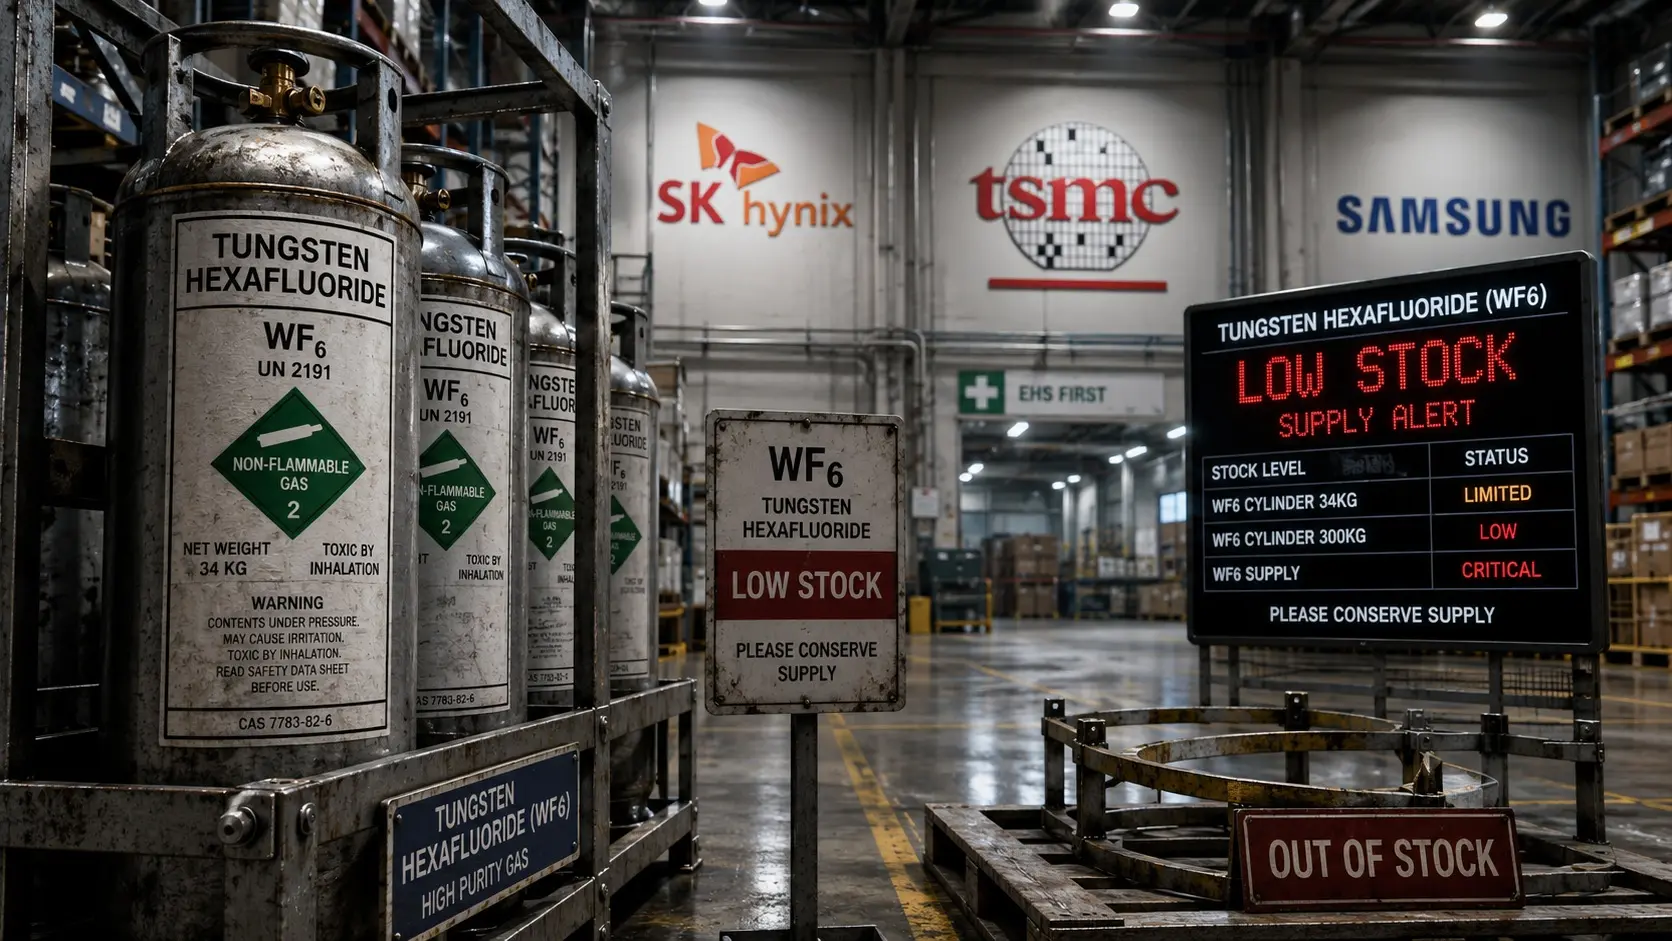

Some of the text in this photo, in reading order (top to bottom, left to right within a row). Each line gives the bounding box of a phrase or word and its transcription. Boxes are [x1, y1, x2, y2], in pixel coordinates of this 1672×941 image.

[969, 166, 1179, 224] tsmc
[657, 180, 854, 238] SK hynix
[1336, 194, 1570, 238] SAMSUNG
[212, 233, 369, 272] TUNGSTEN
[186, 266, 386, 308] HEXAFLUORIDE
[1218, 283, 1547, 342] TUNGSTEN HEXAFLUORIDE (WF6)
[420, 312, 496, 340] NGSTEN
[264, 322, 326, 358] WF6
[420, 337, 507, 367] FLUORIDE
[258, 360, 330, 380] UN 2191
[1238, 332, 1516, 404] LOW STOCK
[423, 378, 469, 407] WF6
[529, 374, 575, 394] NGSTE
[1018, 385, 1107, 403] EHS FIRST
[529, 395, 575, 413] FLUOR
[420, 409, 471, 424] UN 2191
[611, 417, 641, 432] STEN
[1279, 399, 1476, 438] SUPPLY ALERT
[533, 426, 564, 449] WF6
[611, 433, 647, 450] UORIDE
[530, 450, 566, 462] UN 2191
[1464, 448, 1528, 467] STATUS
[233, 456, 350, 475] NON-FLAMMABLE
[611, 460, 626, 479] F6
[768, 446, 844, 488] WF6
[1212, 461, 1306, 480] STOCK LEVEL
[280, 476, 308, 491] GAS
[419, 484, 485, 498] N-FLAMMABLE
[1212, 492, 1358, 513] WF6 CYLINDER 34KG
[1464, 485, 1532, 504] LIMITED
[287, 500, 300, 519] 2
[436, 500, 457, 512] GAS
[762, 497, 851, 515] TUNGSTEN
[441, 519, 451, 534] 2
[743, 521, 871, 539] HEXAFLUORIDE
[1480, 523, 1517, 541] LOW
[546, 536, 553, 548] 2
[1212, 527, 1366, 548] WF6 CYLINDER 300KG
[183, 542, 271, 556] NET WEIGHT
[322, 542, 374, 557] TOXIC BY
[200, 561, 247, 576] 34 KG
[310, 562, 380, 576] INHALATION
[466, 554, 501, 566] TOXIC BY
[459, 569, 504, 580] INHALATION
[1212, 565, 1300, 581] WF6 SUPPLY
[1461, 561, 1542, 579] CRITICAL
[732, 570, 882, 600] LOW STOCK
[251, 596, 324, 610] WARNING
[208, 616, 360, 629] CONTENTS UNDER PRESSURE.
[1270, 606, 1495, 624] PLEASE CONSERVE SUPPLY
[222, 632, 345, 645] MAY CAUSE IRRITATION.
[228, 648, 342, 661] TOXIC BY INHALATION.
[736, 641, 878, 659] PLEASE CONSERVE
[216, 663, 350, 678] READ SAFETY DATA SHEET
[778, 665, 836, 682] SUPPLY
[251, 680, 320, 693] BEFORE USE.
[416, 696, 428, 706] AS
[238, 715, 333, 730] CAS 7783-82-6
[435, 780, 515, 832] TUNGSTEN
[402, 791, 570, 885] HEXAFLUORIDE (WF6)
[1269, 838, 1499, 879] OUT OF STOCK
[422, 847, 529, 920] HIGH PURITY GAS
